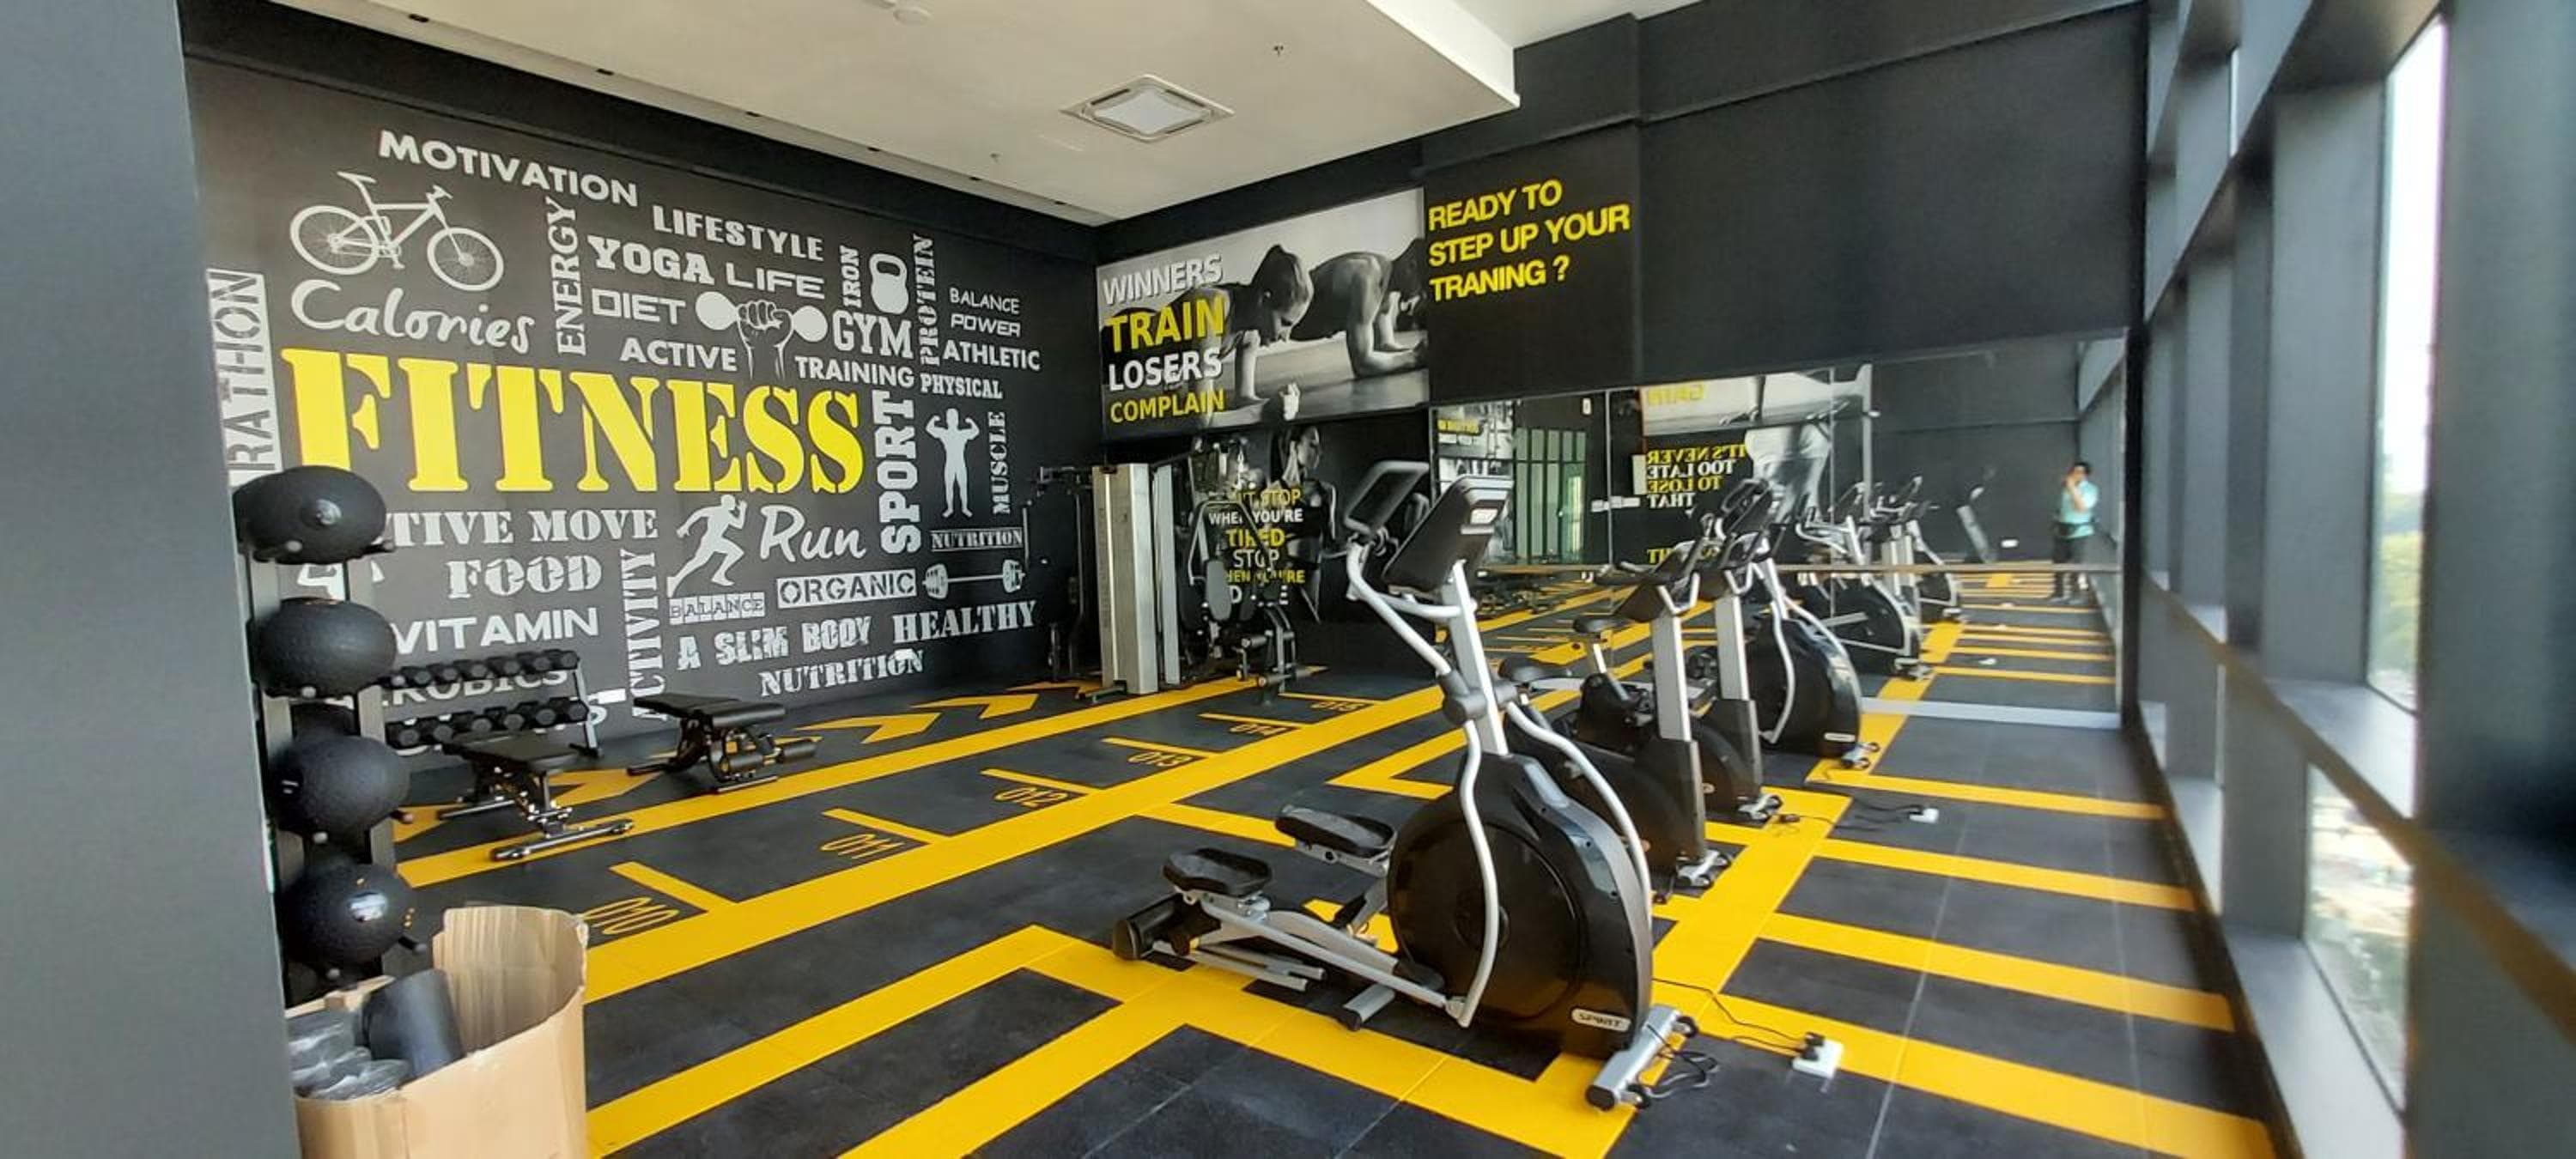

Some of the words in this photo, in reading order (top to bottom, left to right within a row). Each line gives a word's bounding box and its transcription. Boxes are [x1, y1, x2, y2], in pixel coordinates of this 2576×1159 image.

[380, 130, 638, 207] MOTIVATION
[1429, 186, 1516, 231] READY
[1525, 179, 1563, 211] TO
[653, 205, 823, 261] LIFESTYLE
[1429, 228, 1492, 268] STEP
[1499, 220, 1538, 253] UP
[1545, 203, 1630, 243] YOUR
[546, 197, 586, 355] ENERGY
[586, 238, 714, 284] YOGA
[726, 261, 824, 300] LIFE
[841, 246, 861, 308] IRON
[1103, 254, 1223, 306] WINNERS
[1429, 258, 1547, 302] TRANING
[1552, 255, 1571, 282] ?
[290, 279, 535, 354] Calories
[592, 289, 685, 325] DIET
[914, 234, 940, 367] PROTEIN
[950, 288, 1020, 315] BALANCE
[832, 310, 914, 360] GYM
[951, 313, 1021, 337] POWER
[1106, 295, 1225, 354] TRAIN
[620, 337, 737, 372] ACTIVE
[794, 356, 914, 389] TRAINING
[944, 340, 1041, 371] ATHLETIC
[1109, 347, 1223, 391] LOSERS
[920, 373, 1003, 399] PHYSICAL
[1110, 387, 1225, 423] COMPLAIN
[279, 348, 864, 494] FITNESS
[872, 391, 921, 555] SPORT
[988, 411, 1011, 515] MUSCLE
[385, 511, 513, 547] TIVE
[529, 508, 659, 543] MOVE
[759, 505, 866, 562] Run
[932, 530, 1022, 549] NUTRITION
[448, 555, 602, 599] FOOD
[780, 570, 915, 604] ORGANIC
[390, 607, 599, 655] VITAMIN
[670, 596, 765, 622] BALANCE
[892, 600, 1036, 644] HEALTHY
[677, 636, 701, 671] A
[714, 626, 789, 665] SLIM
[801, 616, 872, 654] BODY
[759, 648, 923, 697] NUTRITION
[1128, 750, 1194, 767] 013
[994, 786, 1070, 808] 012
[819, 833, 906, 859] 011
